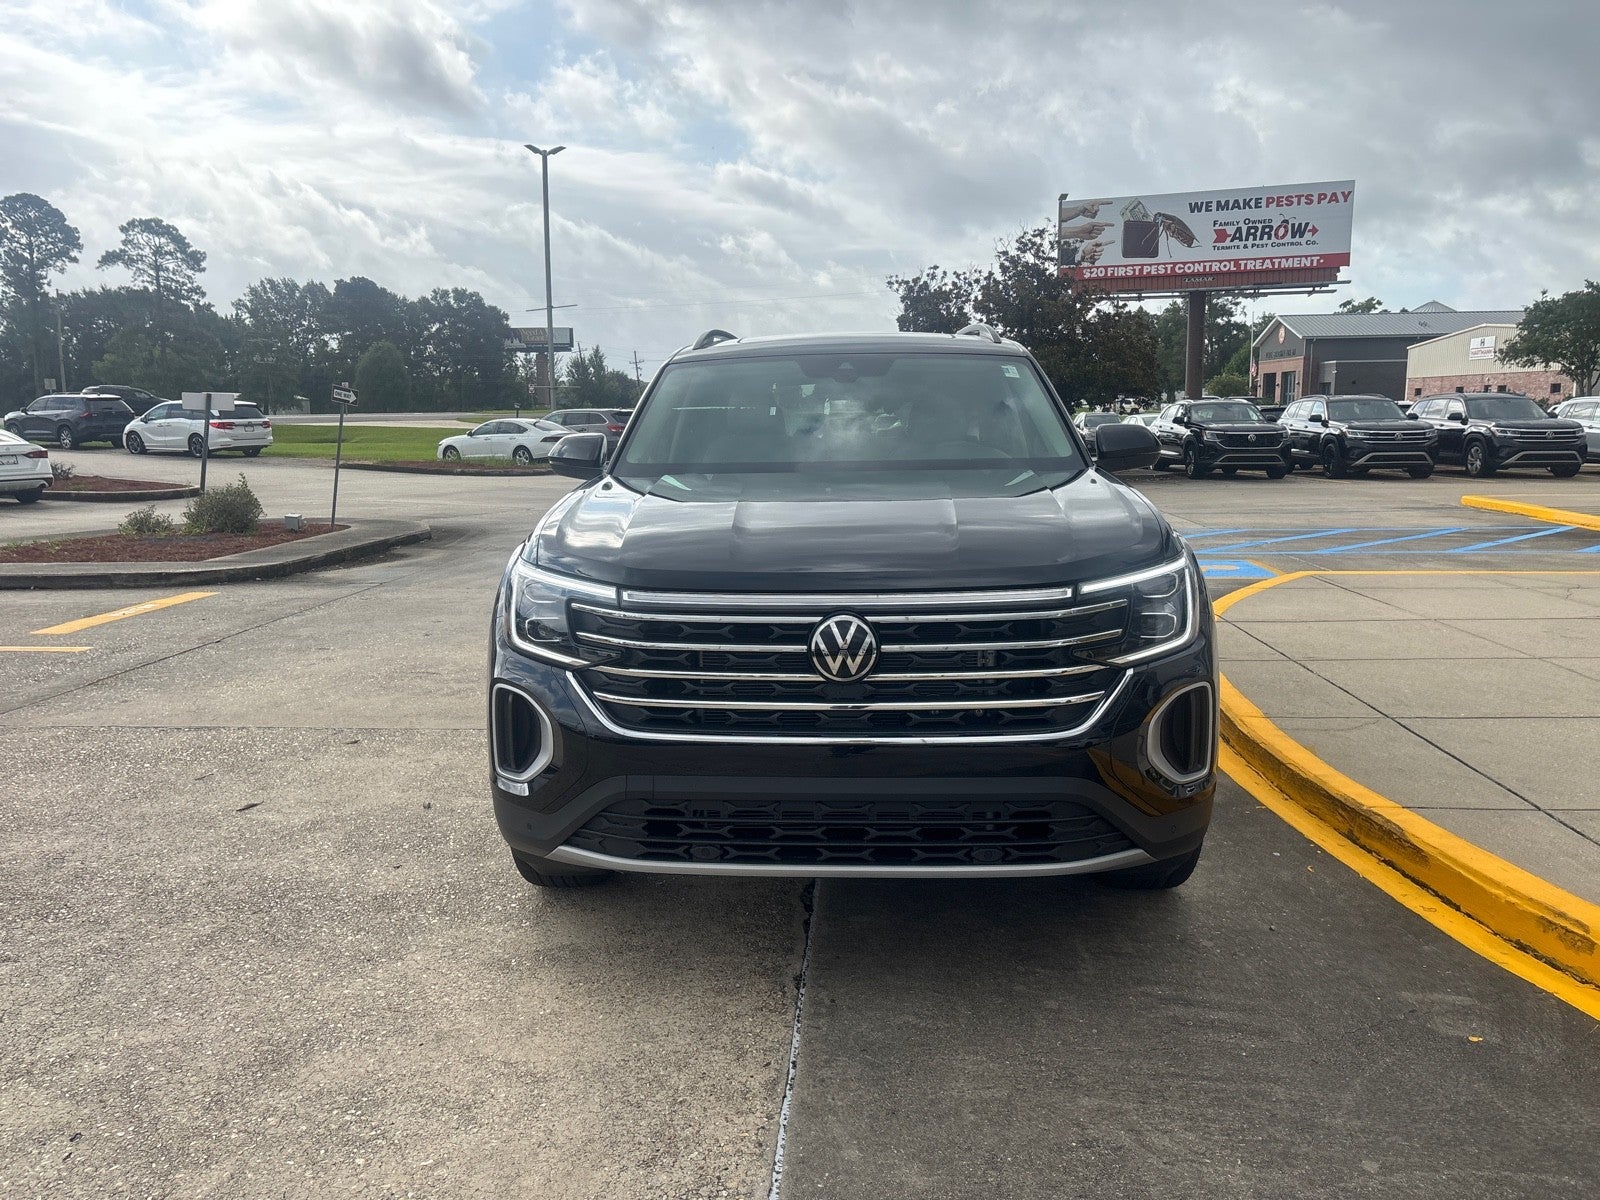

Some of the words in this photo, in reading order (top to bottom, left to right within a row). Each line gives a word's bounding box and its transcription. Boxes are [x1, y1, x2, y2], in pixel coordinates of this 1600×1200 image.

[1188, 200, 1213, 214] WE
[1215, 197, 1263, 212] MAKE
[1265, 194, 1314, 208] PESTS
[1317, 190, 1352, 205] PAY
[1229, 222, 1310, 242] ARROW
[1083, 267, 1105, 279] $20
[1107, 265, 1142, 277] FIRST
[1143, 264, 1173, 275] PEST
[1175, 261, 1237, 274] CONTROL
[810, 614, 877, 682] VW
